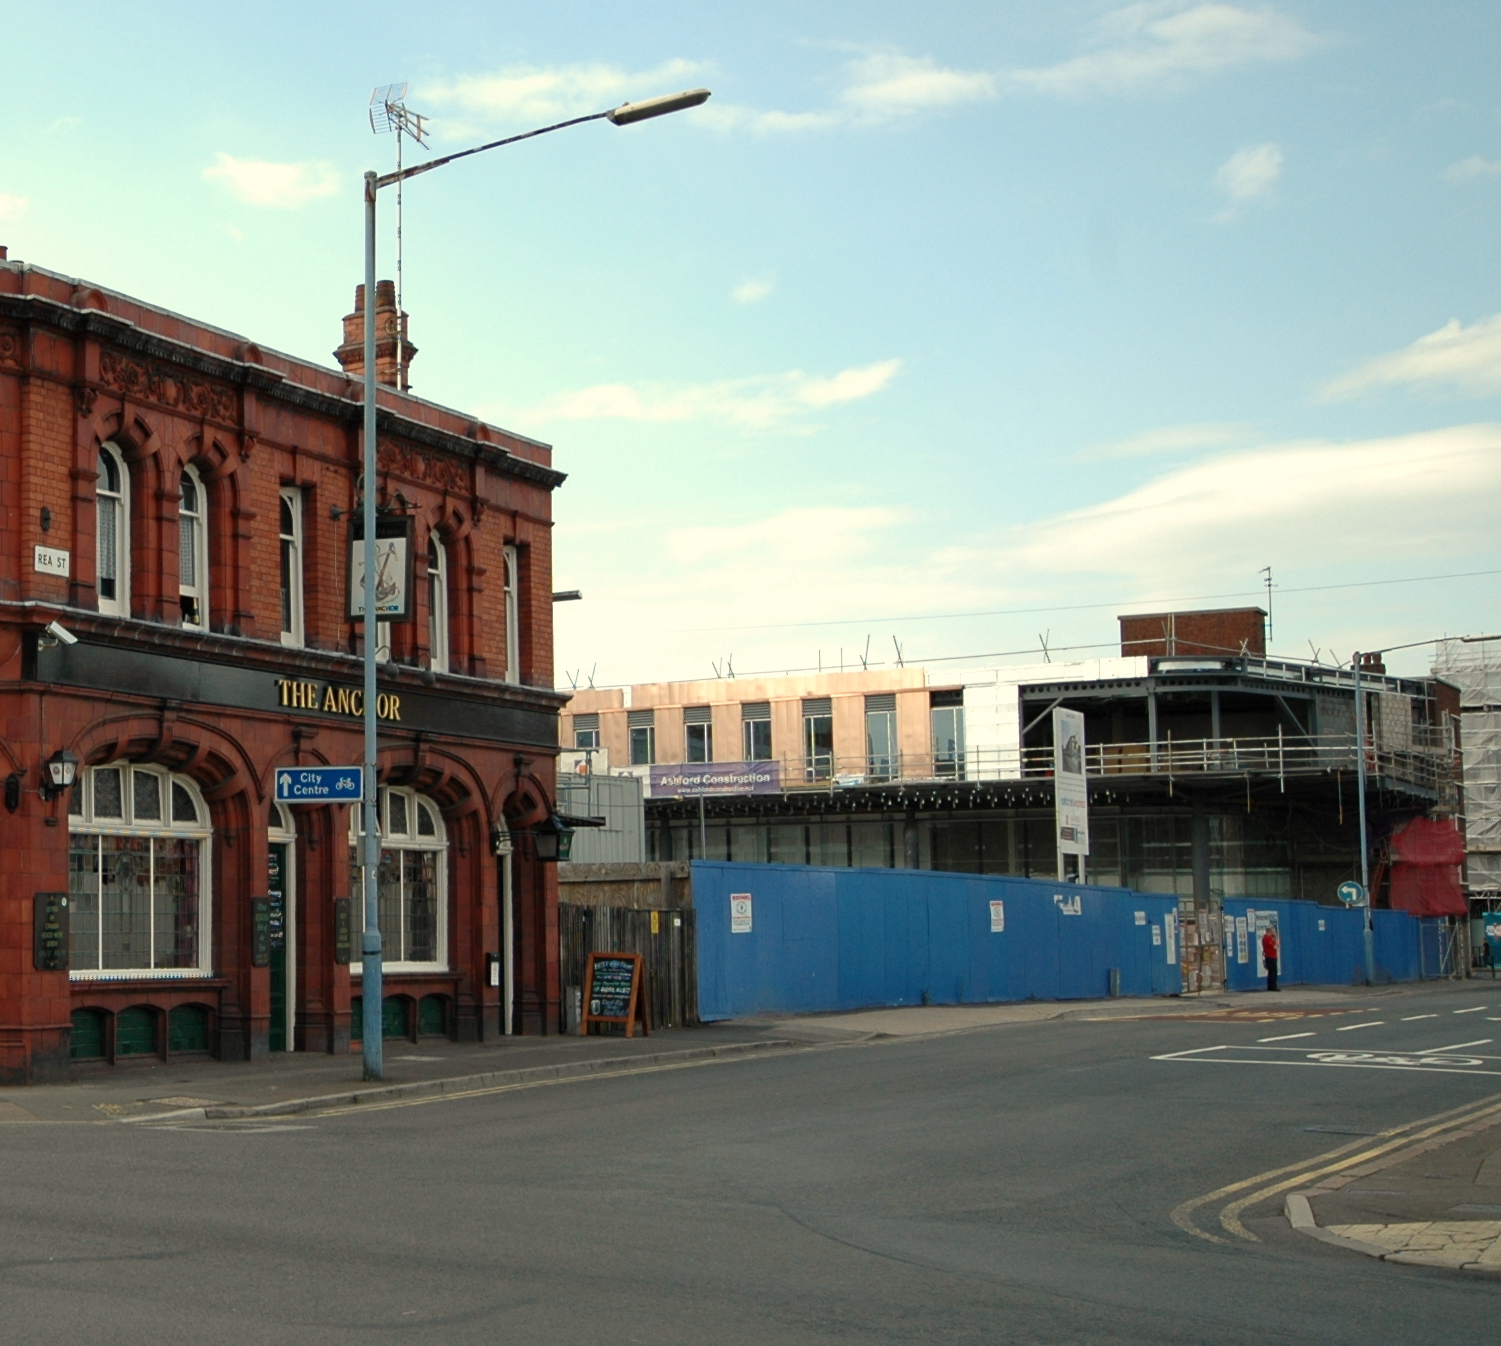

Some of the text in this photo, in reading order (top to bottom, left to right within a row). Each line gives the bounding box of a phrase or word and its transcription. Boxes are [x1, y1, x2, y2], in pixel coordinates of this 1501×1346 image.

[38, 554, 66, 569] REA ST
[279, 679, 401, 721] THE ANCOR
[300, 772, 322, 785] City
[660, 772, 770, 786] Ashford Construction
[293, 784, 329, 795] Centre
